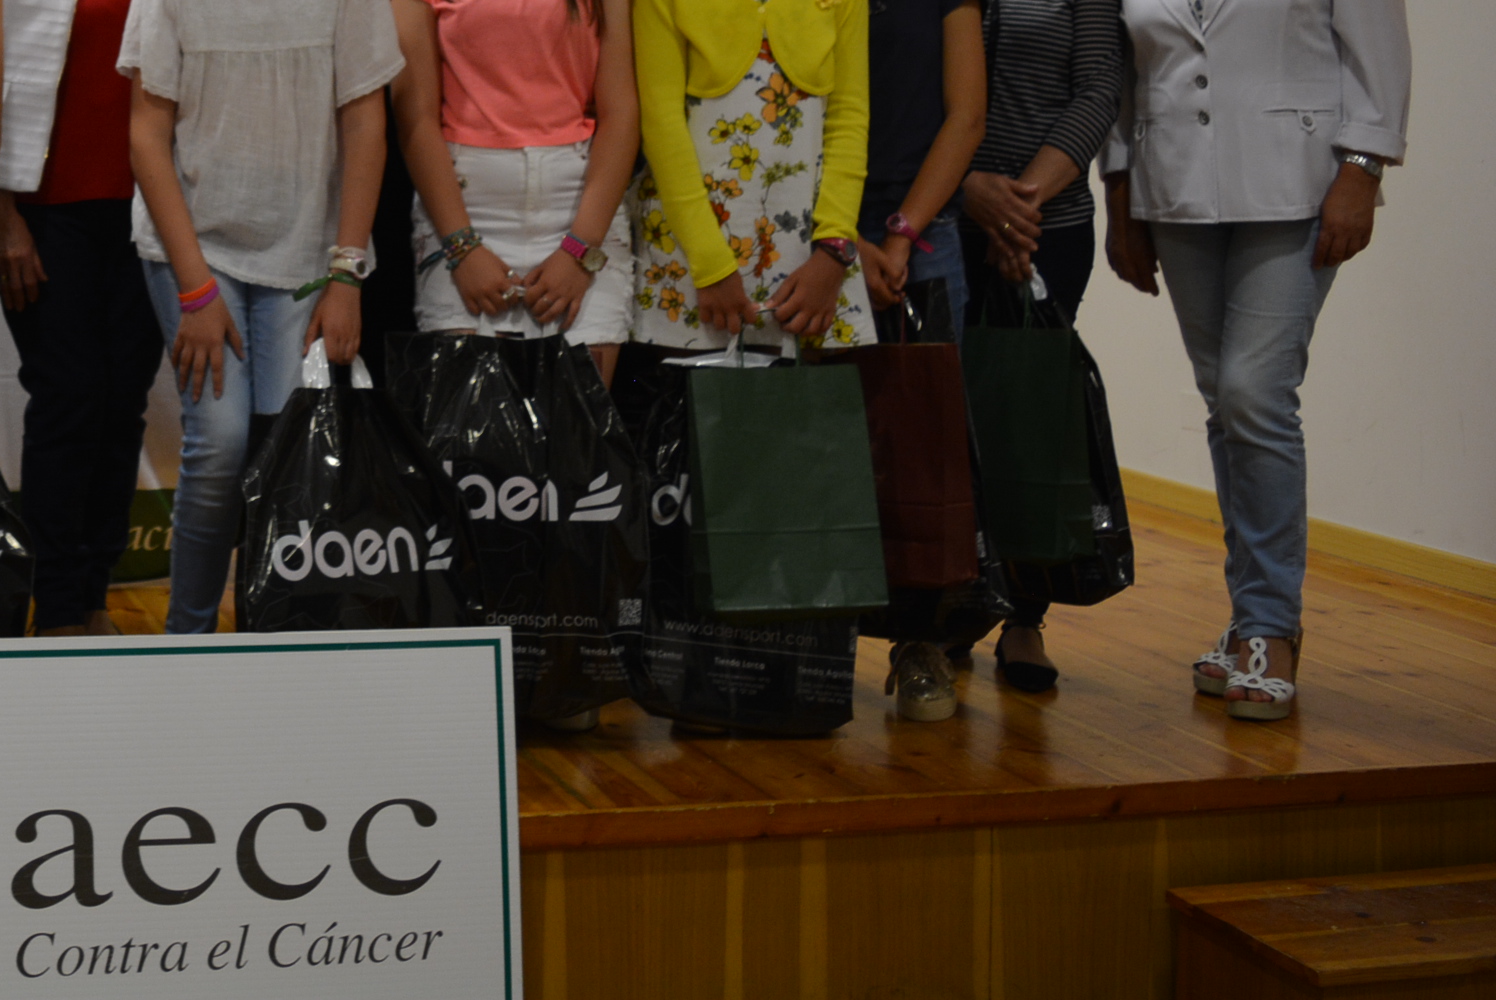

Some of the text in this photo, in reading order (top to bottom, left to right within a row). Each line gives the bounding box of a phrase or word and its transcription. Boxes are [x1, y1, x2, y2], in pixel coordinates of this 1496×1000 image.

[272, 519, 419, 581] daen
[664, 619, 819, 648] www.daensport.com
[10, 798, 442, 910] aecc
[16, 921, 444, 979] Contra el Cáncer
